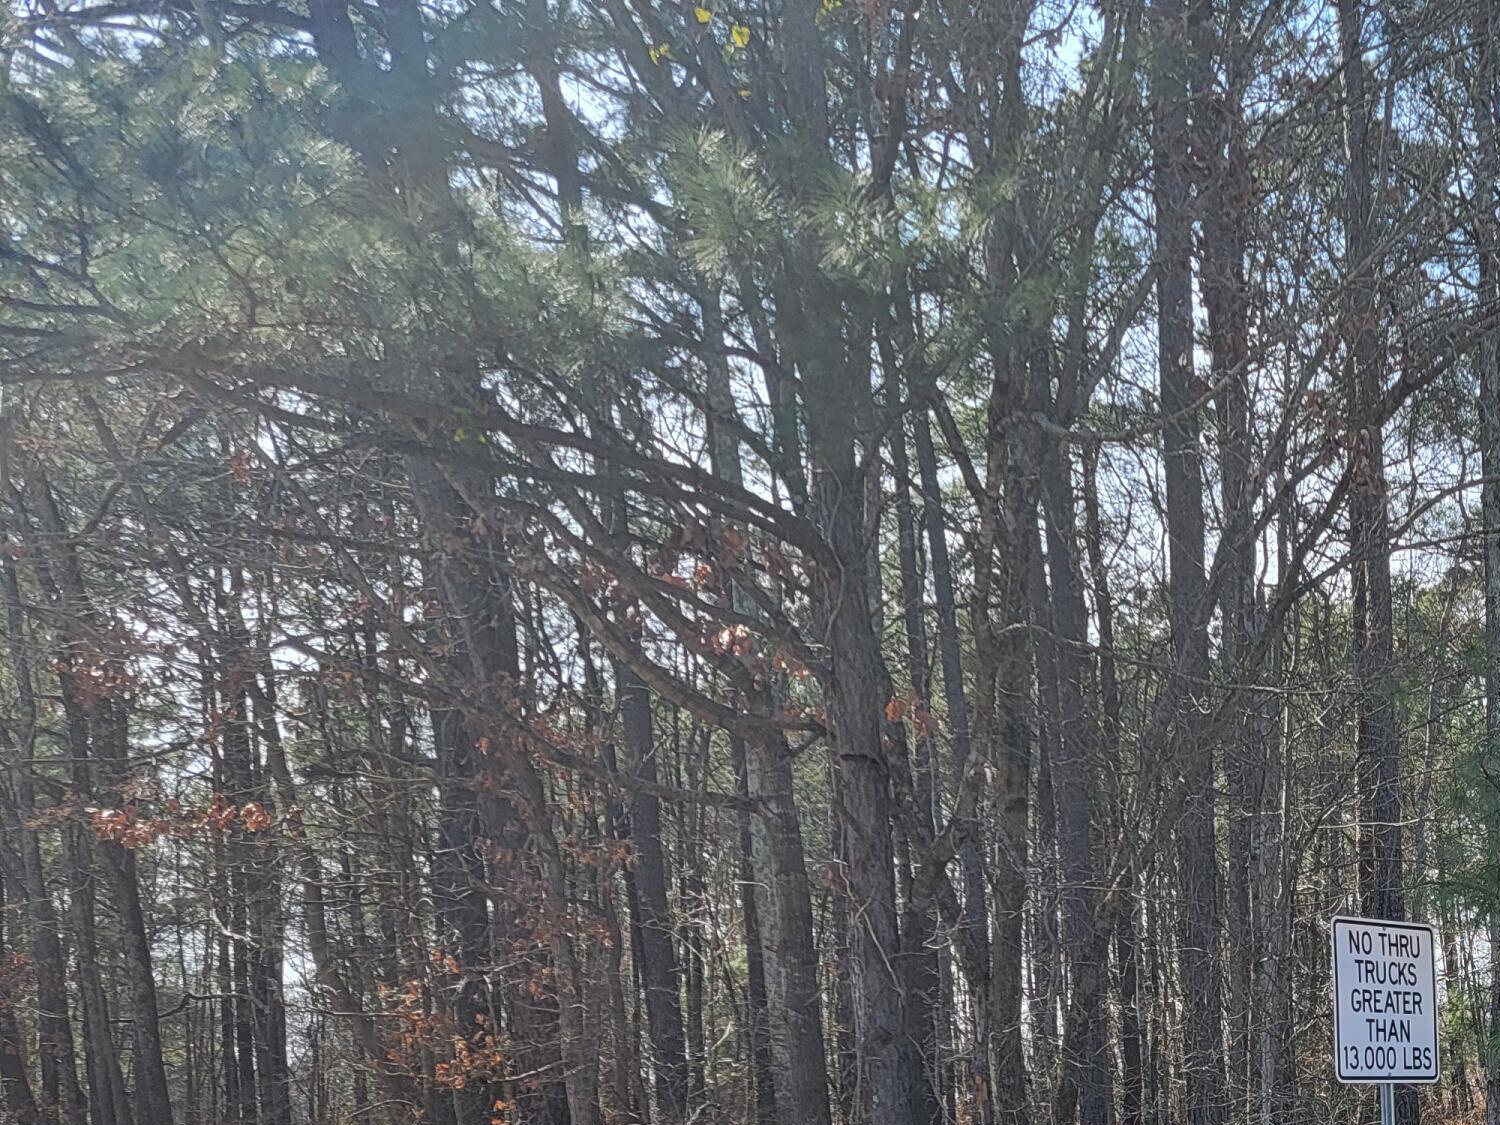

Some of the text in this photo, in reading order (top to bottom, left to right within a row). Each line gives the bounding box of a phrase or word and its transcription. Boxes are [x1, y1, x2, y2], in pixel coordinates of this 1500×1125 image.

[1348, 929, 1420, 958] NO THRU
[1354, 959, 1418, 986] TRUCKS
[1350, 988, 1423, 1015] GREATER
[1365, 1018, 1411, 1043] THAN
[1343, 1045, 1432, 1072] 13,000 LBS
